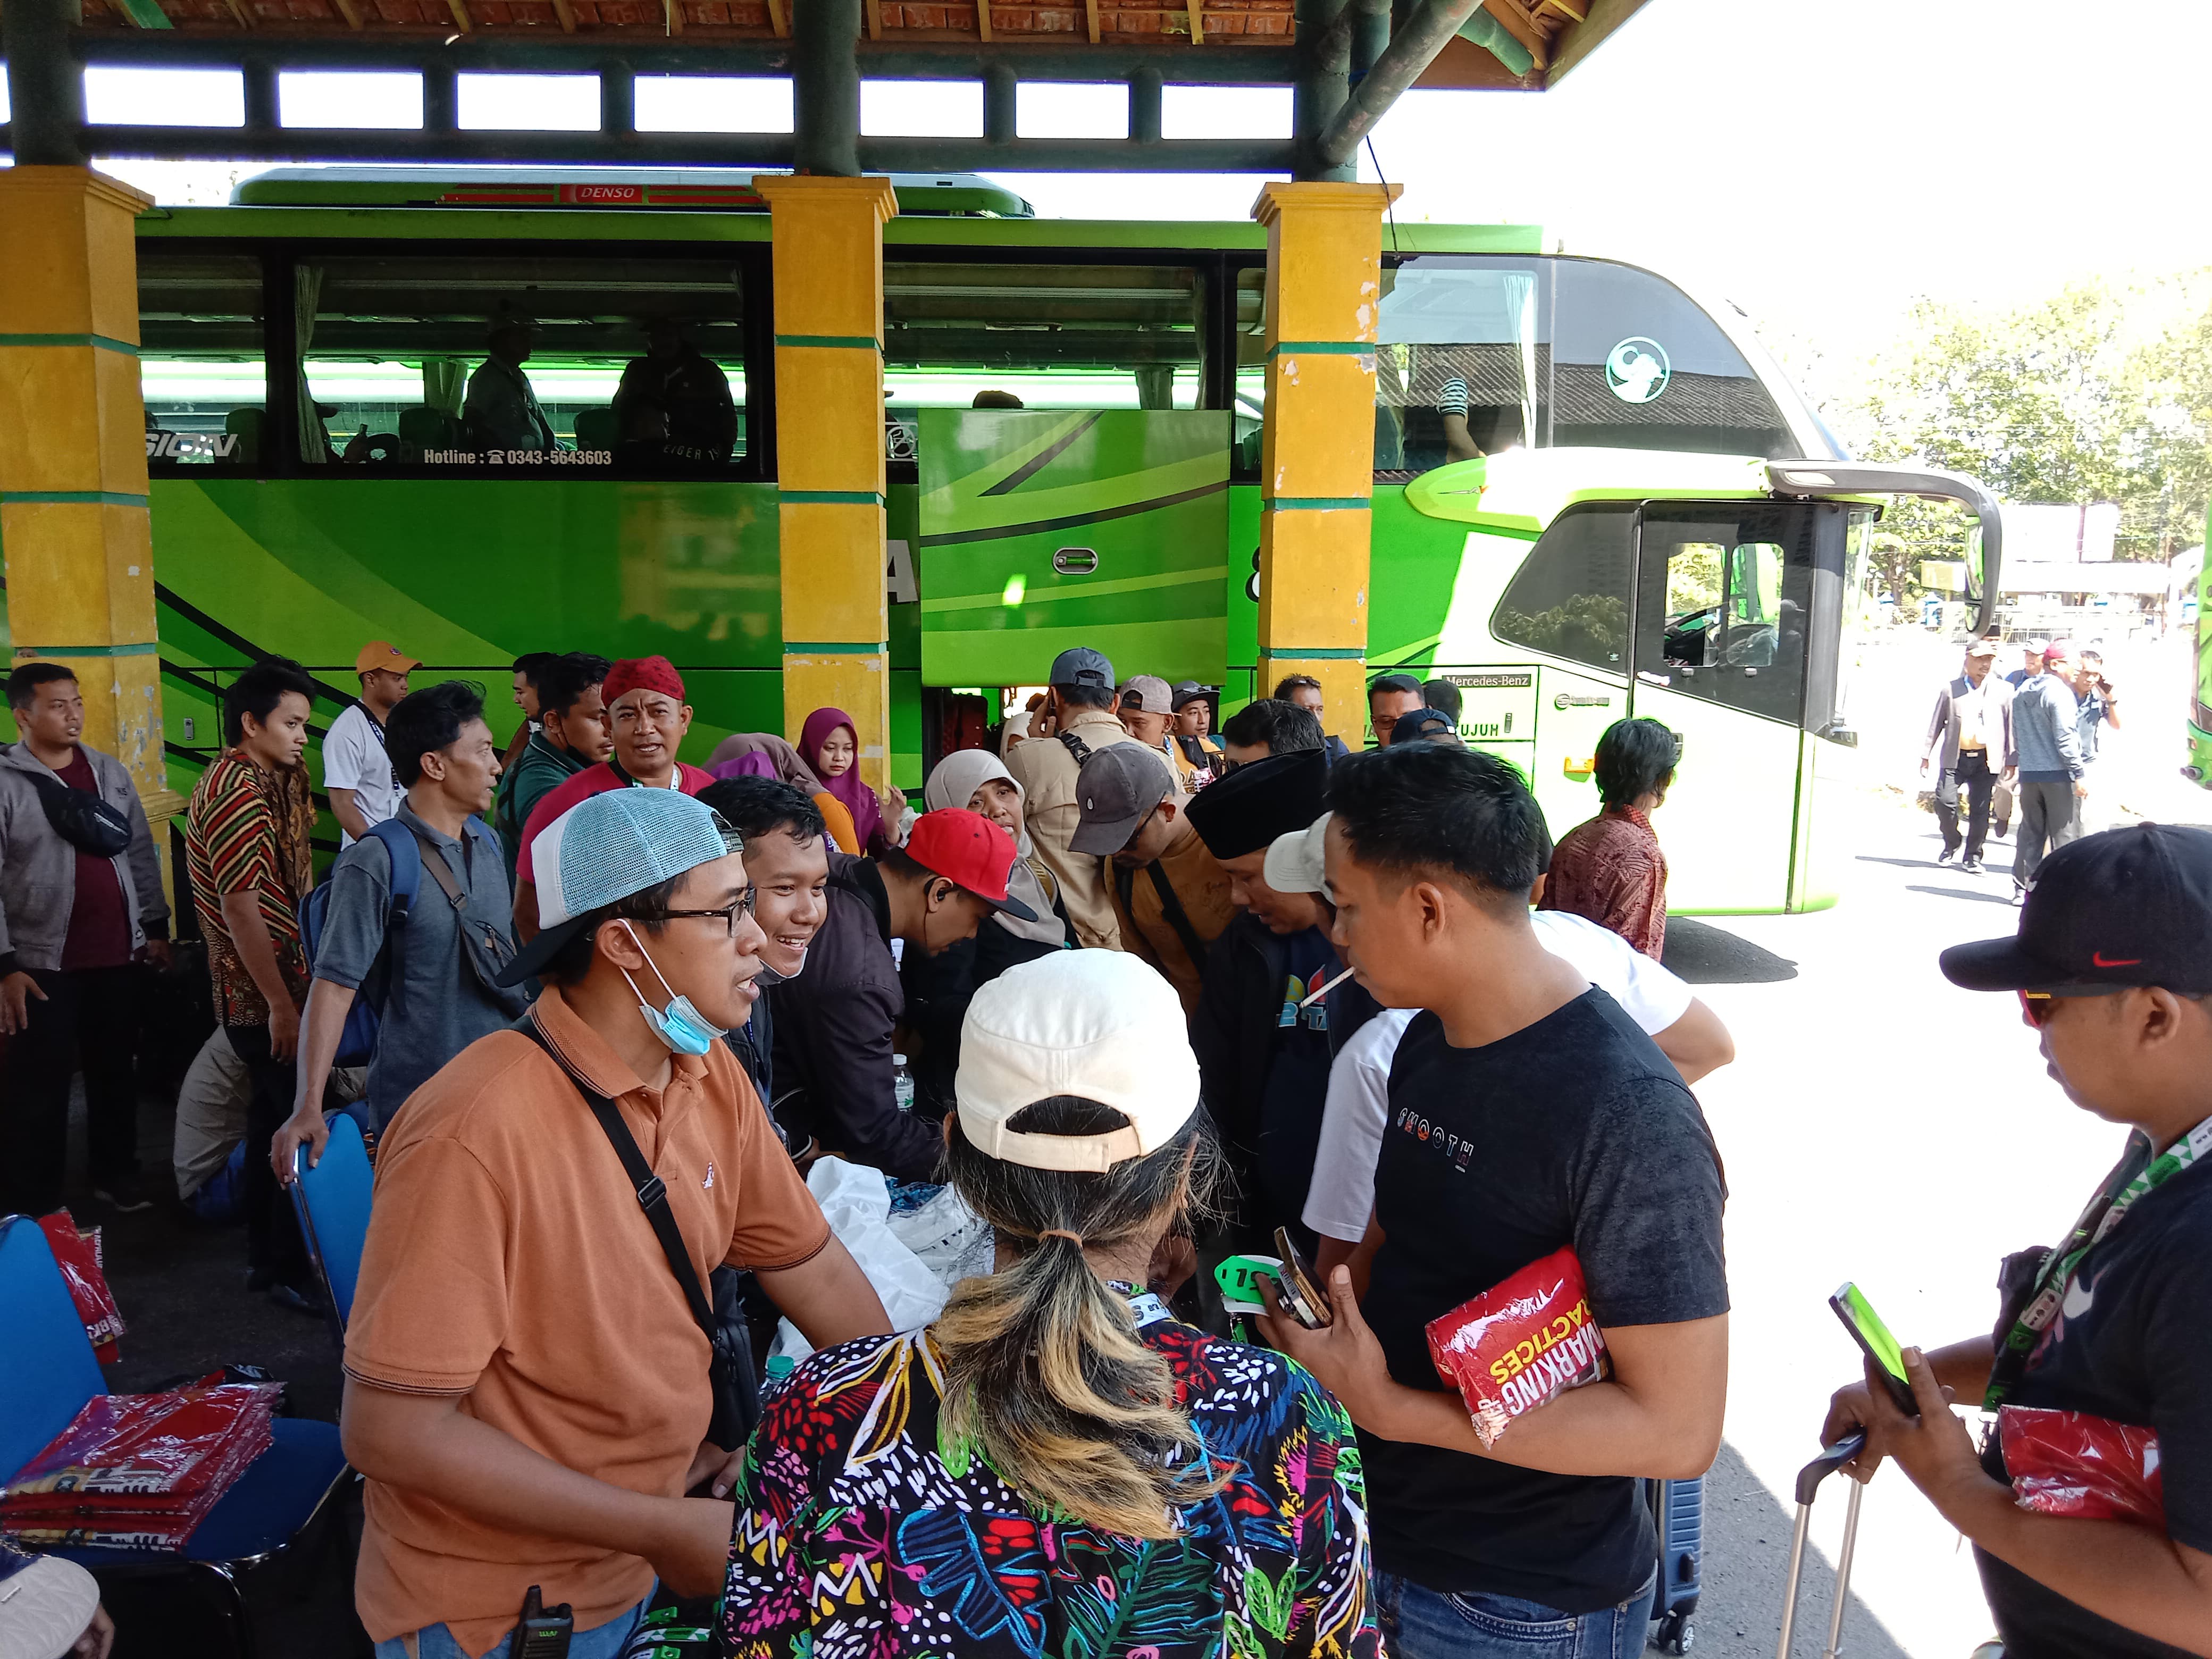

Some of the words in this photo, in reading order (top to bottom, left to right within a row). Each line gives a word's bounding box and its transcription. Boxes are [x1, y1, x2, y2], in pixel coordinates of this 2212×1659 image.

[581, 187, 635, 198] DENSO
[424, 449, 476, 464] Hotline
[507, 450, 612, 465] 0343-5643603
[1445, 675, 1529, 686] Mercedes-Benz
